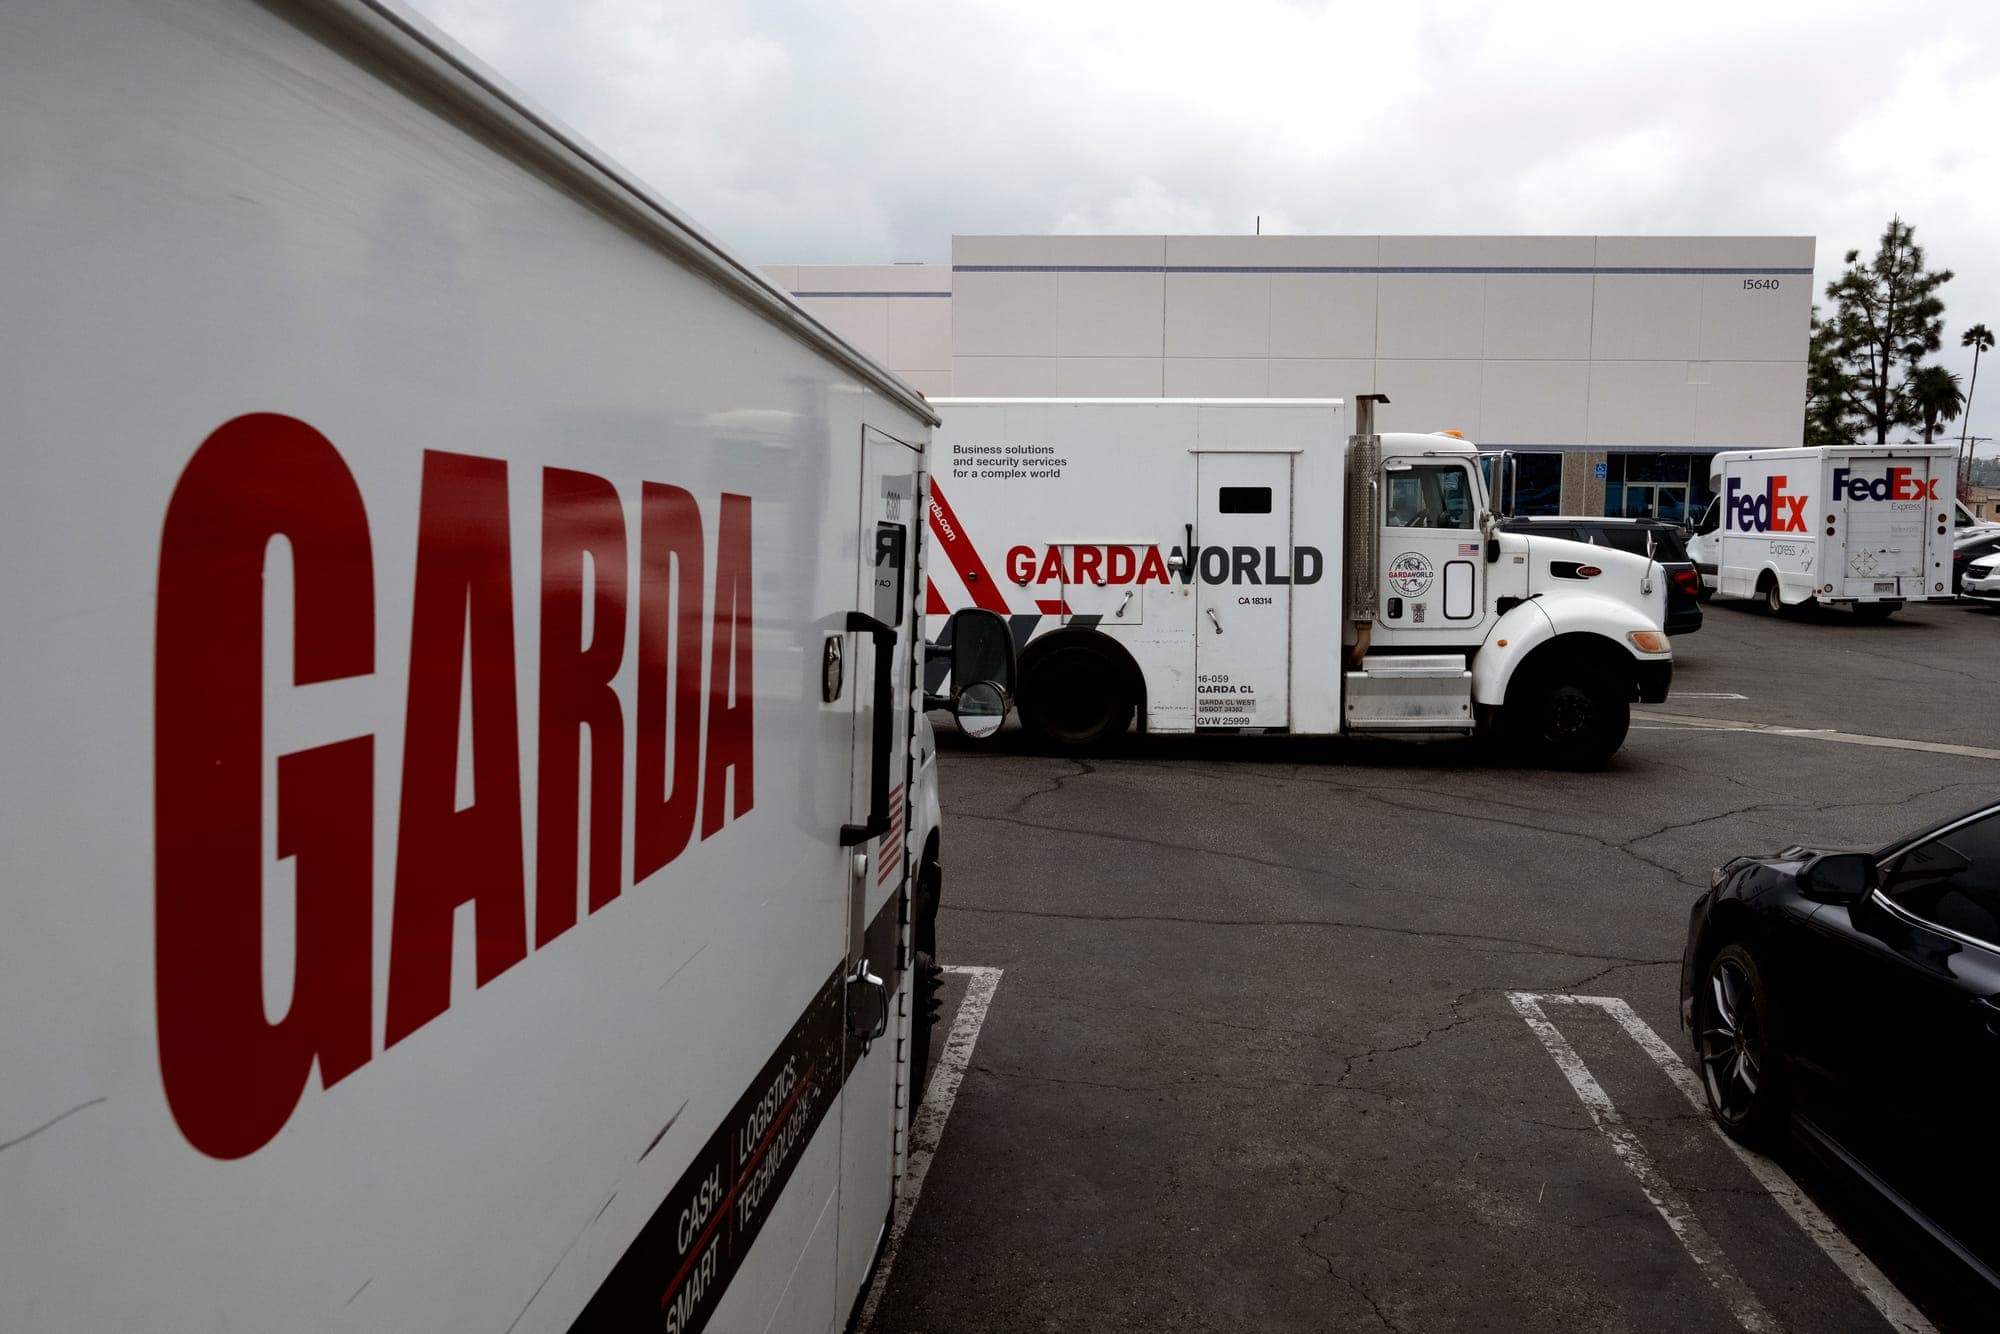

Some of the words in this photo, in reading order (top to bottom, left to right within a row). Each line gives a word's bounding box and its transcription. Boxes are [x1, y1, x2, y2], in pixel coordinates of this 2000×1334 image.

[1743, 279, 1780, 290] 15640
[953, 444, 1002, 454] Business
[1005, 444, 1055, 454] solutions
[953, 456, 974, 466] and
[976, 456, 1020, 468] security
[1022, 456, 1068, 466] services
[953, 468, 969, 478] for
[971, 470, 978, 478] a
[981, 468, 1027, 480] complex
[1030, 468, 1061, 478] world
[1832, 467, 1940, 501] FedEx
[1726, 475, 1808, 533] FedEx
[1890, 502, 1922, 513] Express
[1769, 540, 1796, 558] Express
[1005, 545, 1324, 586] GARDAWORLD
[1238, 597, 1250, 605] CA
[1252, 597, 1272, 605] 18314
[1198, 674, 1229, 683] 16-059
[1197, 685, 1237, 694] GARDA
[1240, 685, 1255, 694] CL
[1197, 717, 1221, 725] GVW
[1222, 717, 1250, 725] 25999
[153, 411, 755, 1161] GARDA
[666, 1232, 721, 1334] SMART
